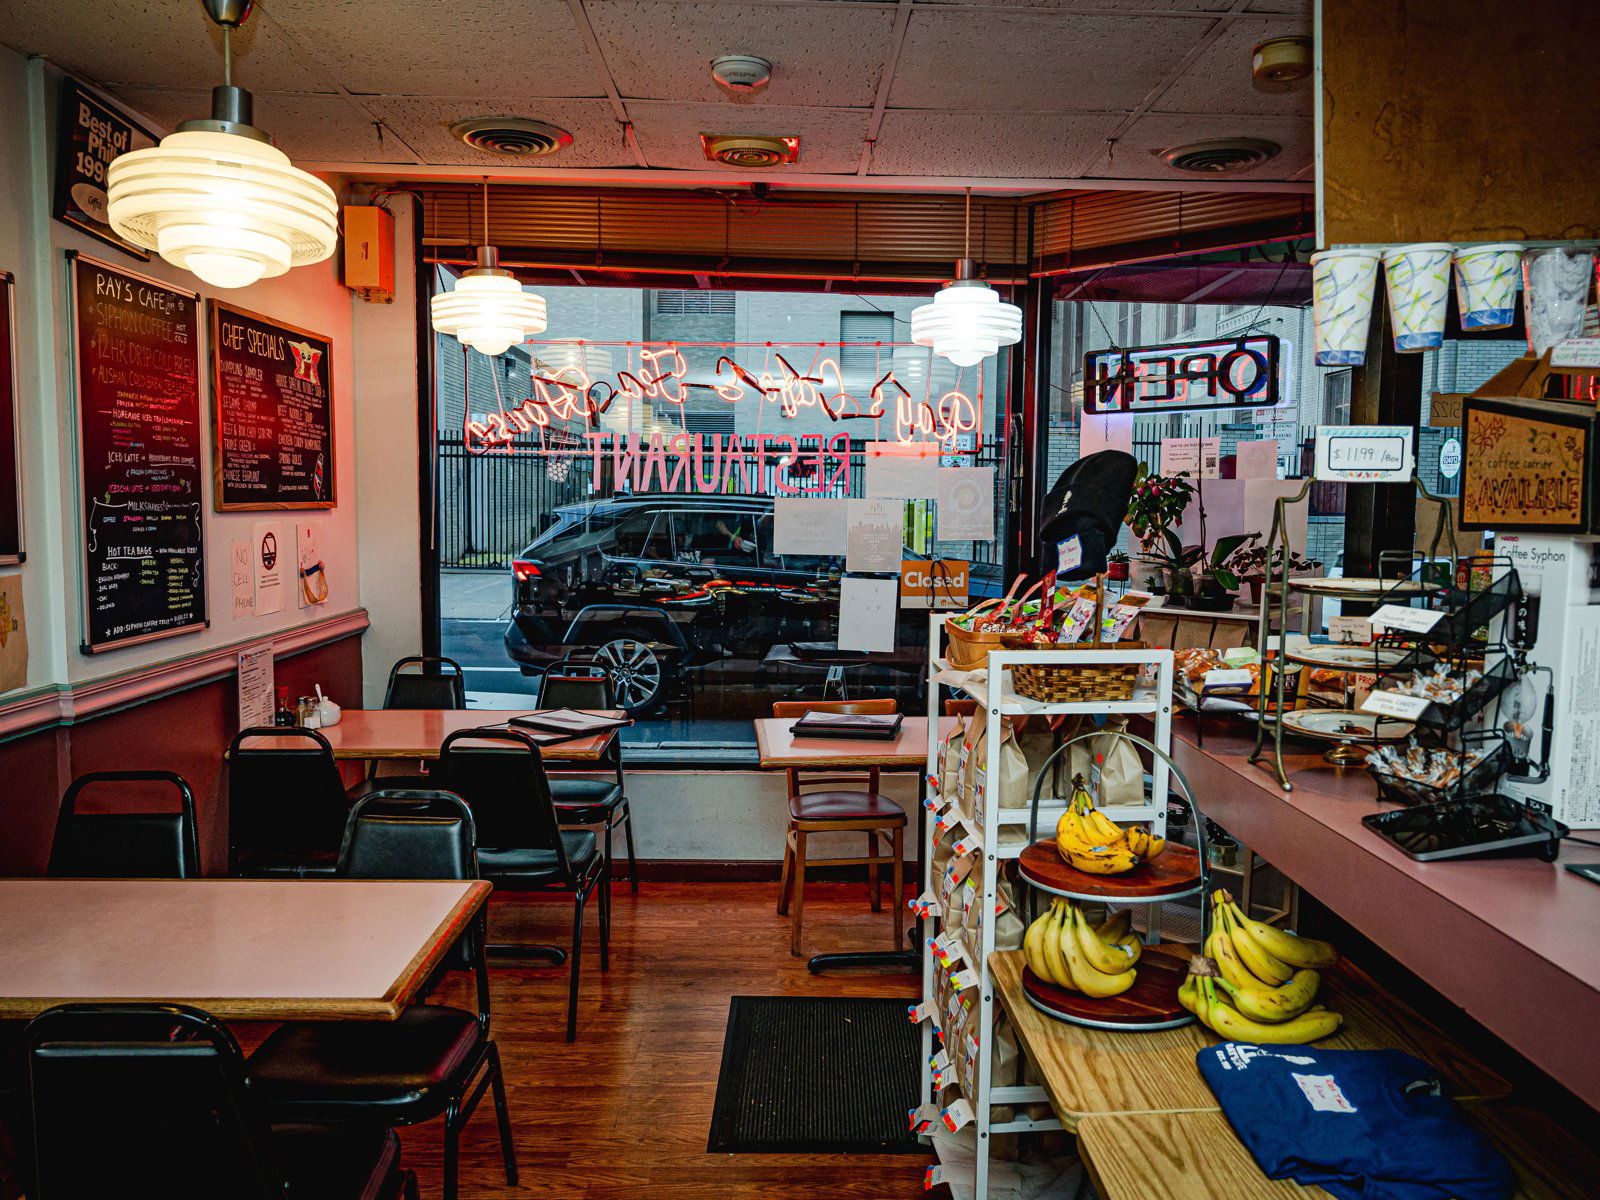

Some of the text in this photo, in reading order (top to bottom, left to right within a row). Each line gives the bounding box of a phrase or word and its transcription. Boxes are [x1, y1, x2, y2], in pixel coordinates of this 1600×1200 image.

[79, 102, 128, 152] Best of
[88, 132, 119, 164] Phill
[76, 152, 109, 187] 199
[96, 274, 133, 302] RAY'S
[139, 287, 165, 310] CAFE
[97, 303, 138, 333] SIPHON
[138, 313, 172, 342] COFFEE
[111, 337, 128, 364] HR
[129, 342, 152, 367] DRIP
[222, 322, 285, 361] CHEF SPECIALS
[108, 451, 123, 463] ICED
[124, 453, 140, 463] LATTE
[1487, 452, 1554, 470] coffee carrier
[1479, 477, 1579, 511] AVAILABLE
[108, 546, 121, 557] HOT
[123, 546, 136, 556] TEA
[137, 546, 152, 555] BAGS
[236, 548, 248, 566] NO
[1500, 545, 1566, 565] Coffee Syphon
[234, 572, 249, 587] CELL
[904, 571, 965, 588] Closed
[235, 597, 254, 608] PHONE
